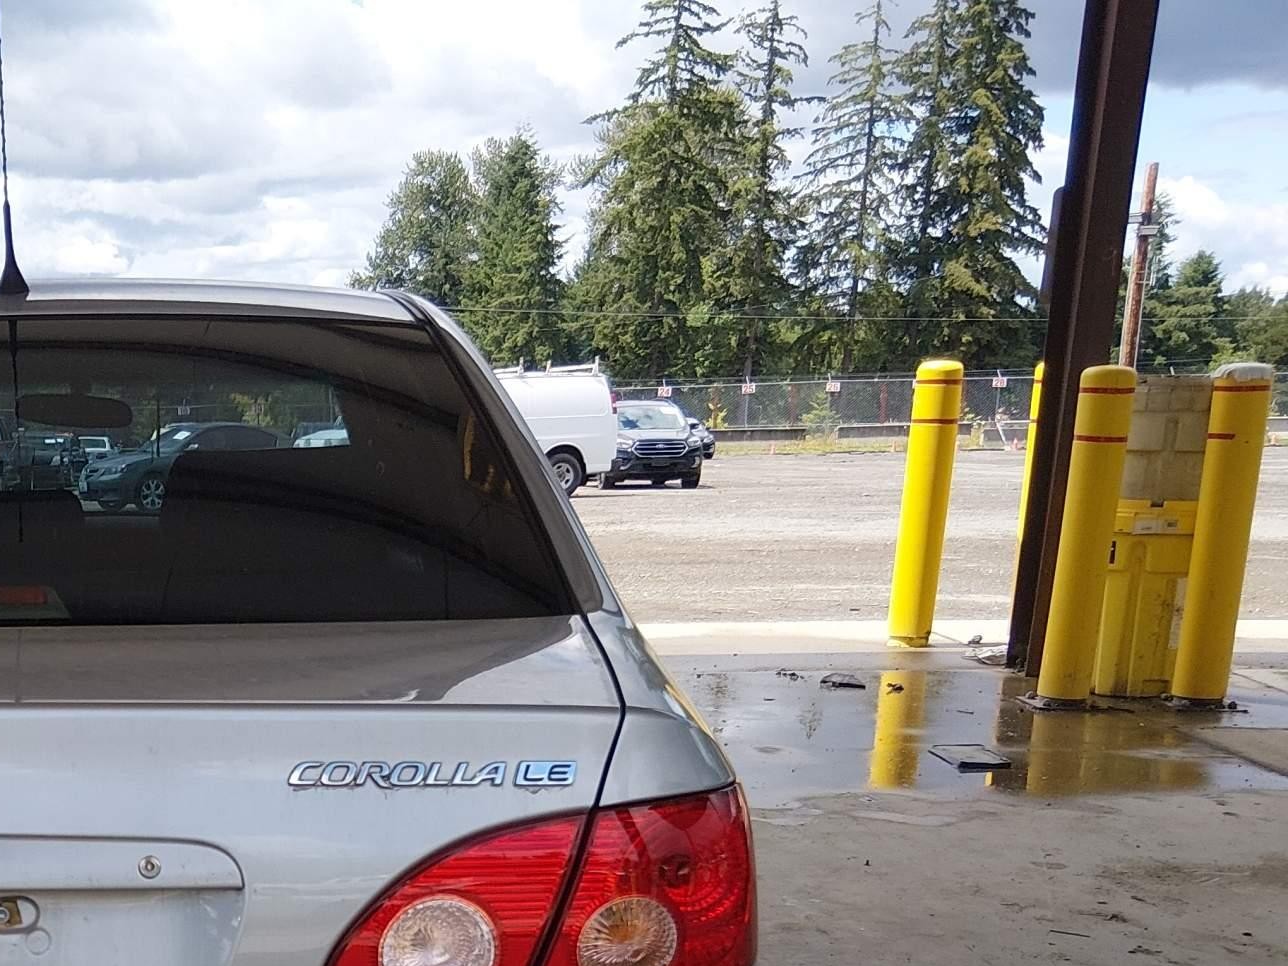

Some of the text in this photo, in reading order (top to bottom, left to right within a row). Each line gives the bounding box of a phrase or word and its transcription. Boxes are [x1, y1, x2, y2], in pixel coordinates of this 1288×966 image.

[743, 385, 754, 394] 25
[288, 760, 575, 788] COROLLA LE
